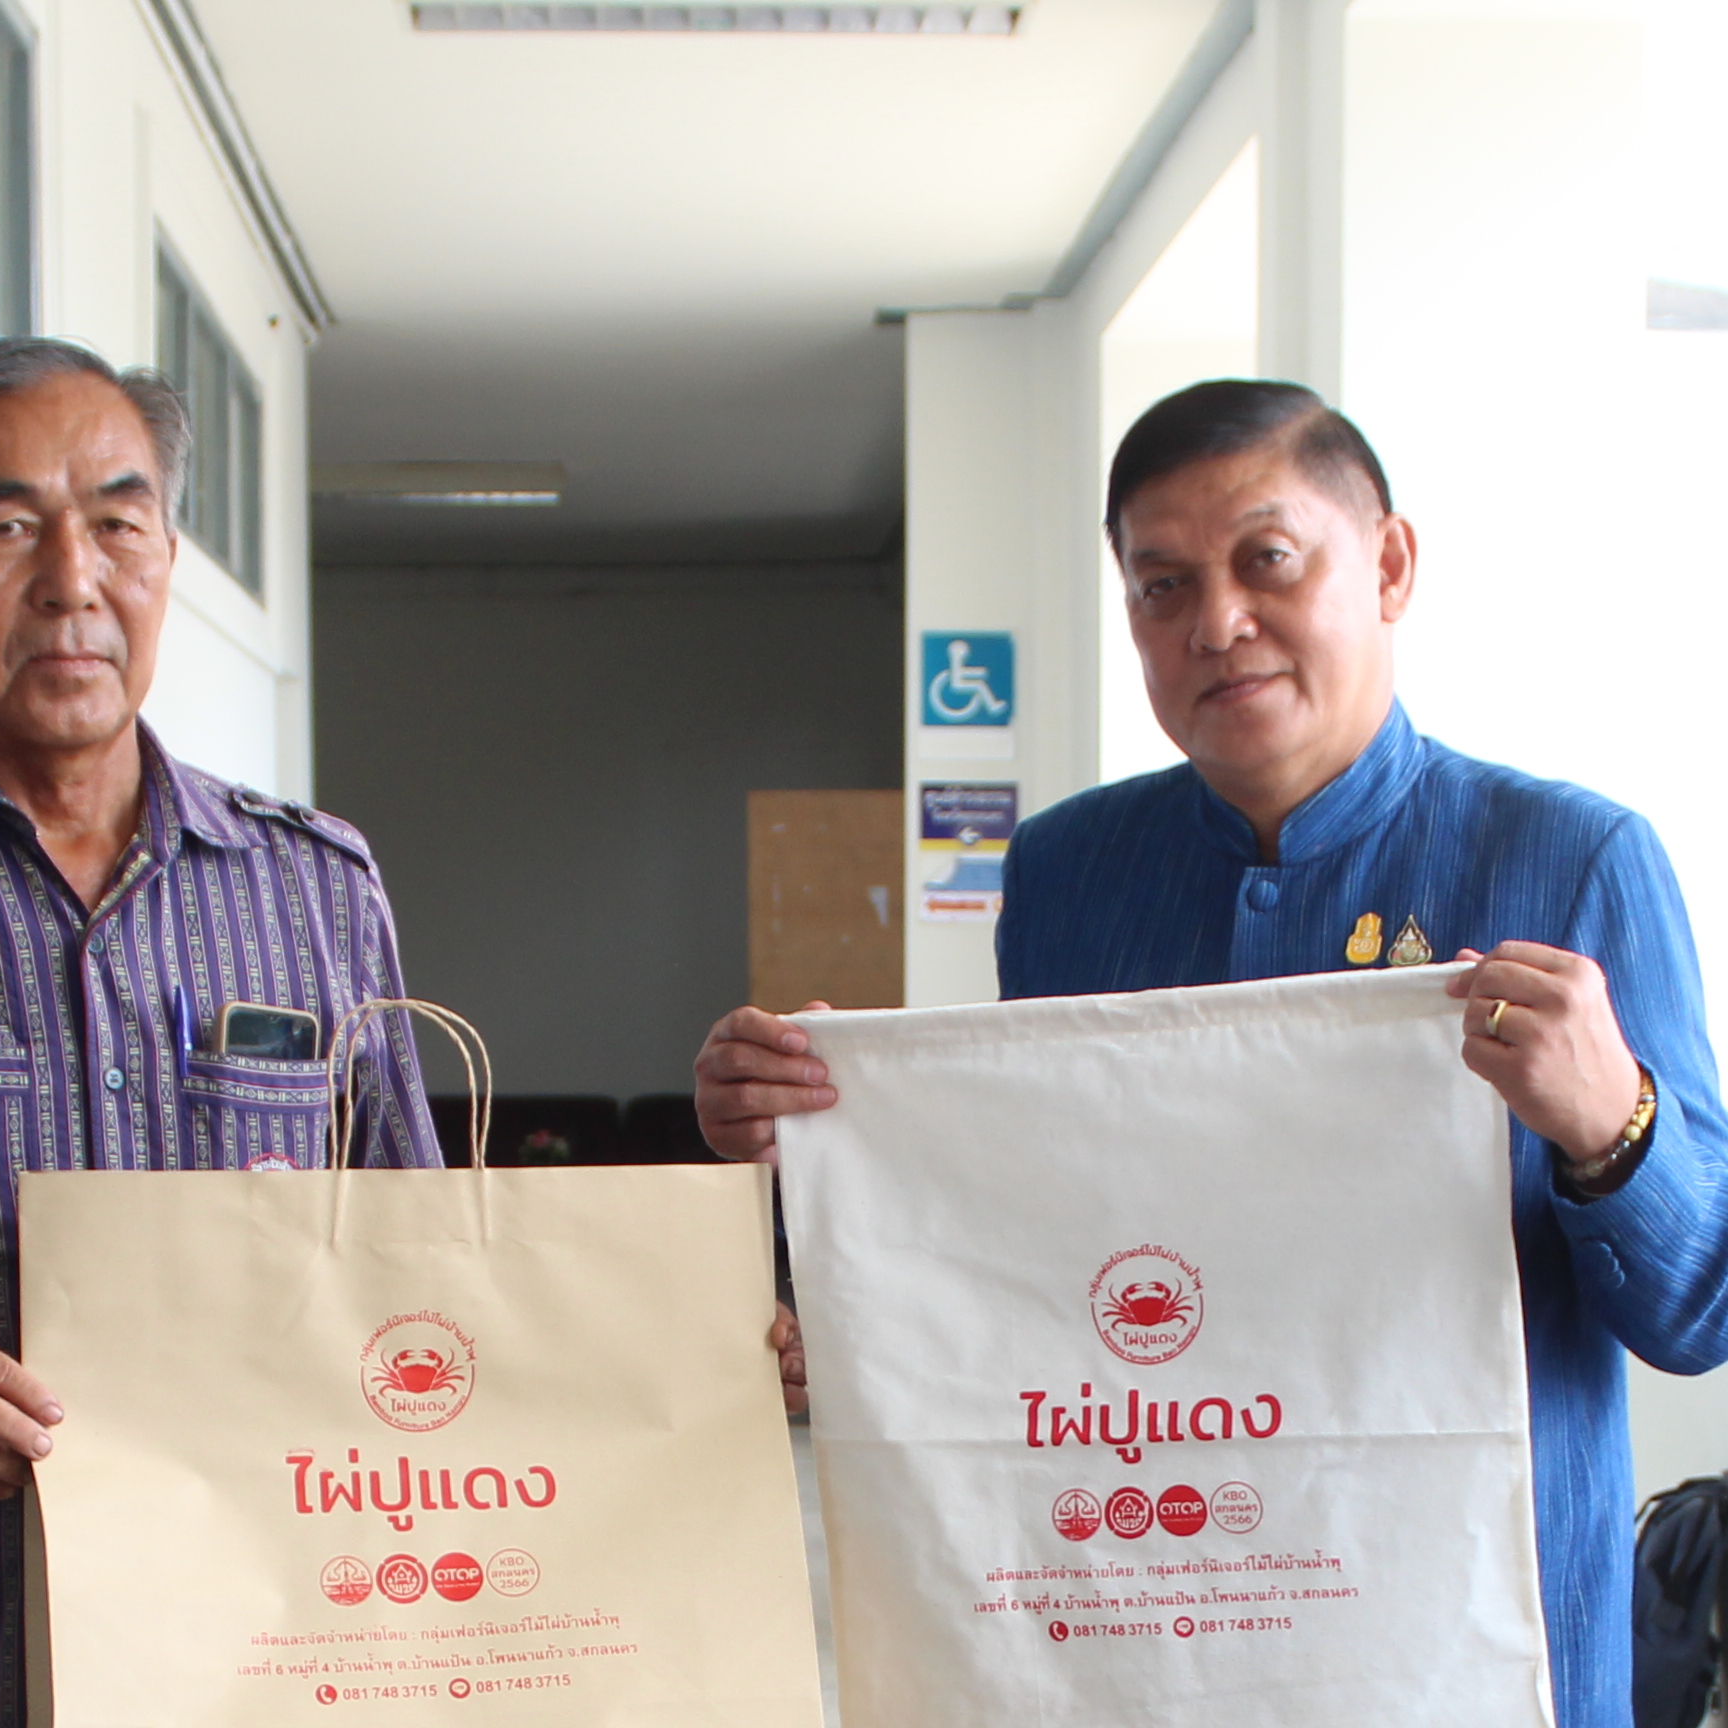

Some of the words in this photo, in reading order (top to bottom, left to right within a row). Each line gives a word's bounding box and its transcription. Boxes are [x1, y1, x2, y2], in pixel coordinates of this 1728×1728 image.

[1123, 1331, 1178, 1349] ไผ่ปูแดง
[390, 1398, 447, 1416] ไผ่ปูแดง
[1019, 1382, 1283, 1464] ไผ่ปูแดง
[285, 1448, 556, 1532] ไผ่ปูแดง
[1223, 1490, 1248, 1501] KBO
[1159, 1501, 1204, 1516] OTOP
[1215, 1503, 1258, 1514] สกลนคร
[1223, 1514, 1253, 1525] 2566
[499, 1556, 525, 1567] KBO
[434, 1567, 480, 1582] OTOP
[491, 1568, 535, 1579] สกลนคร
[500, 1578, 529, 1589] 2566
[1011, 1600, 1019, 1611] 6
[1053, 1600, 1061, 1610] 4
[1073, 1625, 1097, 1637] 081
[1100, 1624, 1126, 1637] 748
[1128, 1622, 1162, 1636] 3715
[1200, 1620, 1224, 1633] 081
[1228, 1618, 1255, 1631] 748
[1258, 1616, 1293, 1630] 3715
[275, 1664, 284, 1675] 6
[322, 1662, 330, 1673] 4
[343, 1688, 368, 1700] 081
[372, 1686, 399, 1699] 748
[402, 1684, 438, 1698] 3715
[476, 1679, 502, 1693] 081
[506, 1677, 532, 1690] 748
[536, 1674, 571, 1688] 3715
